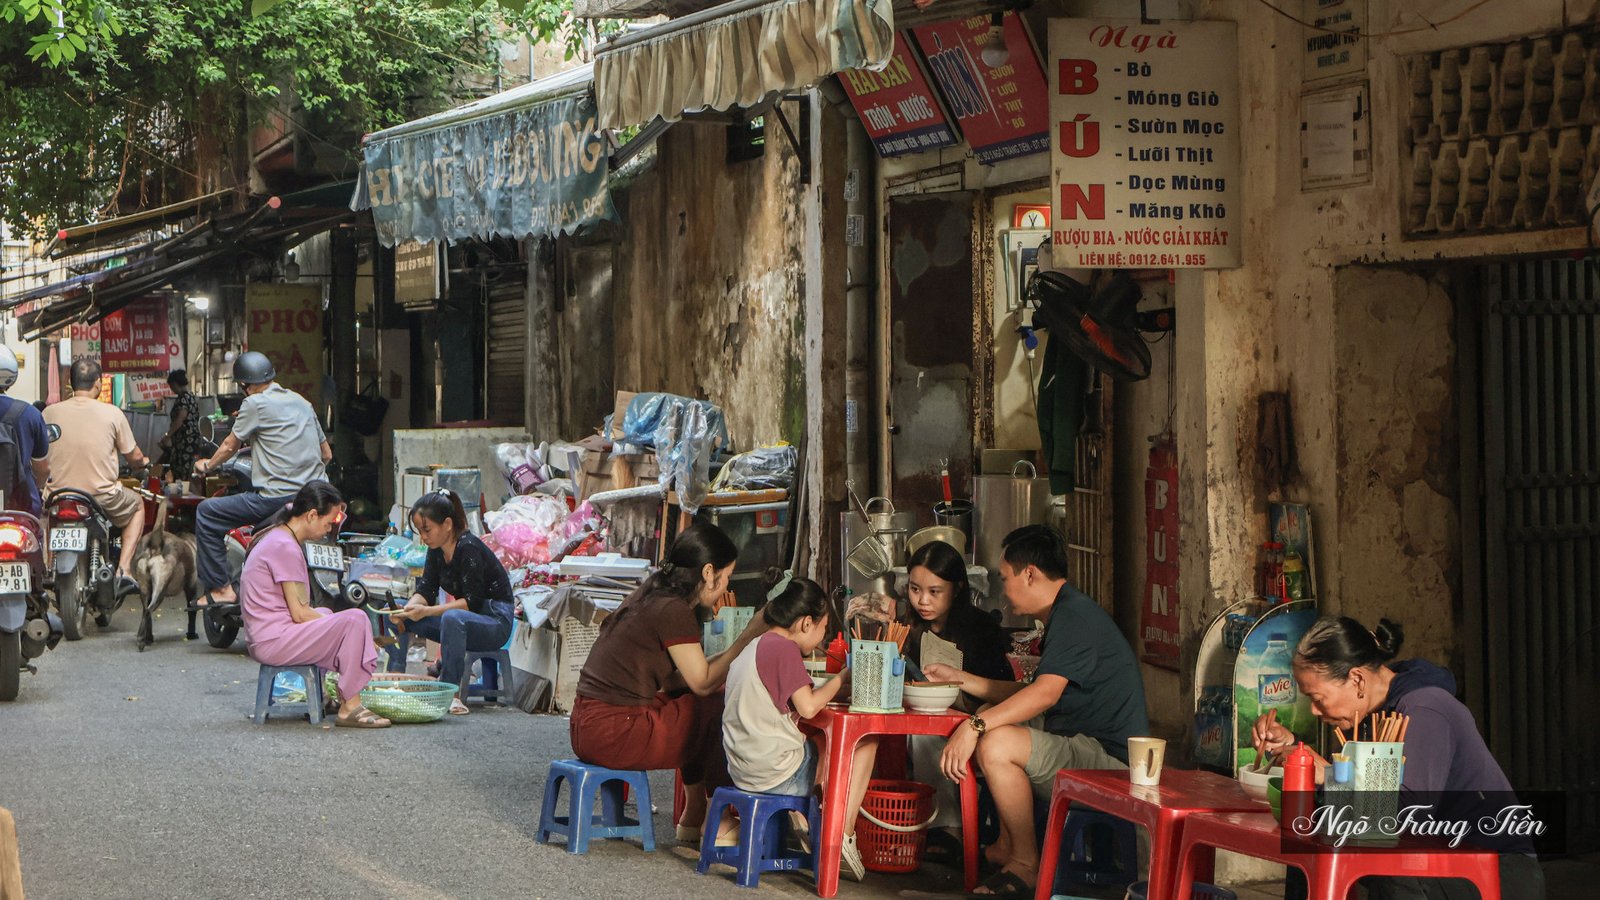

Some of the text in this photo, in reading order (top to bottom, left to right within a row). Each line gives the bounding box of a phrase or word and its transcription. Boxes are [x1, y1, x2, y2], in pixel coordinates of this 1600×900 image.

[1089, 24, 1179, 53] Ngà
[1306, 32, 1341, 53] HYUNDAI
[1127, 62, 1152, 77] Bò
[1127, 90, 1219, 107] Móng Giò
[863, 92, 935, 133] TRỘN NƯỚC
[1128, 118, 1225, 138] Sườn Mọc
[1058, 58, 1106, 220] BÚN
[1128, 147, 1213, 165] Lưỡi Thịt
[1128, 175, 1225, 193] Dọc Mùng
[1129, 202, 1226, 220] Măng Khô
[1054, 225, 1229, 249] RƯỢU BIA NƯỚC GIẢI KHÁT
[1079, 251, 1206, 268] LIÊN HỆ: 0912.641.955
[104, 338, 129, 353] RANG
[55, 529, 81, 539] 29-C1
[51, 539, 84, 549] 656.05
[313, 556, 340, 569] 0685
[0, 579, 27, 591] 7.81
